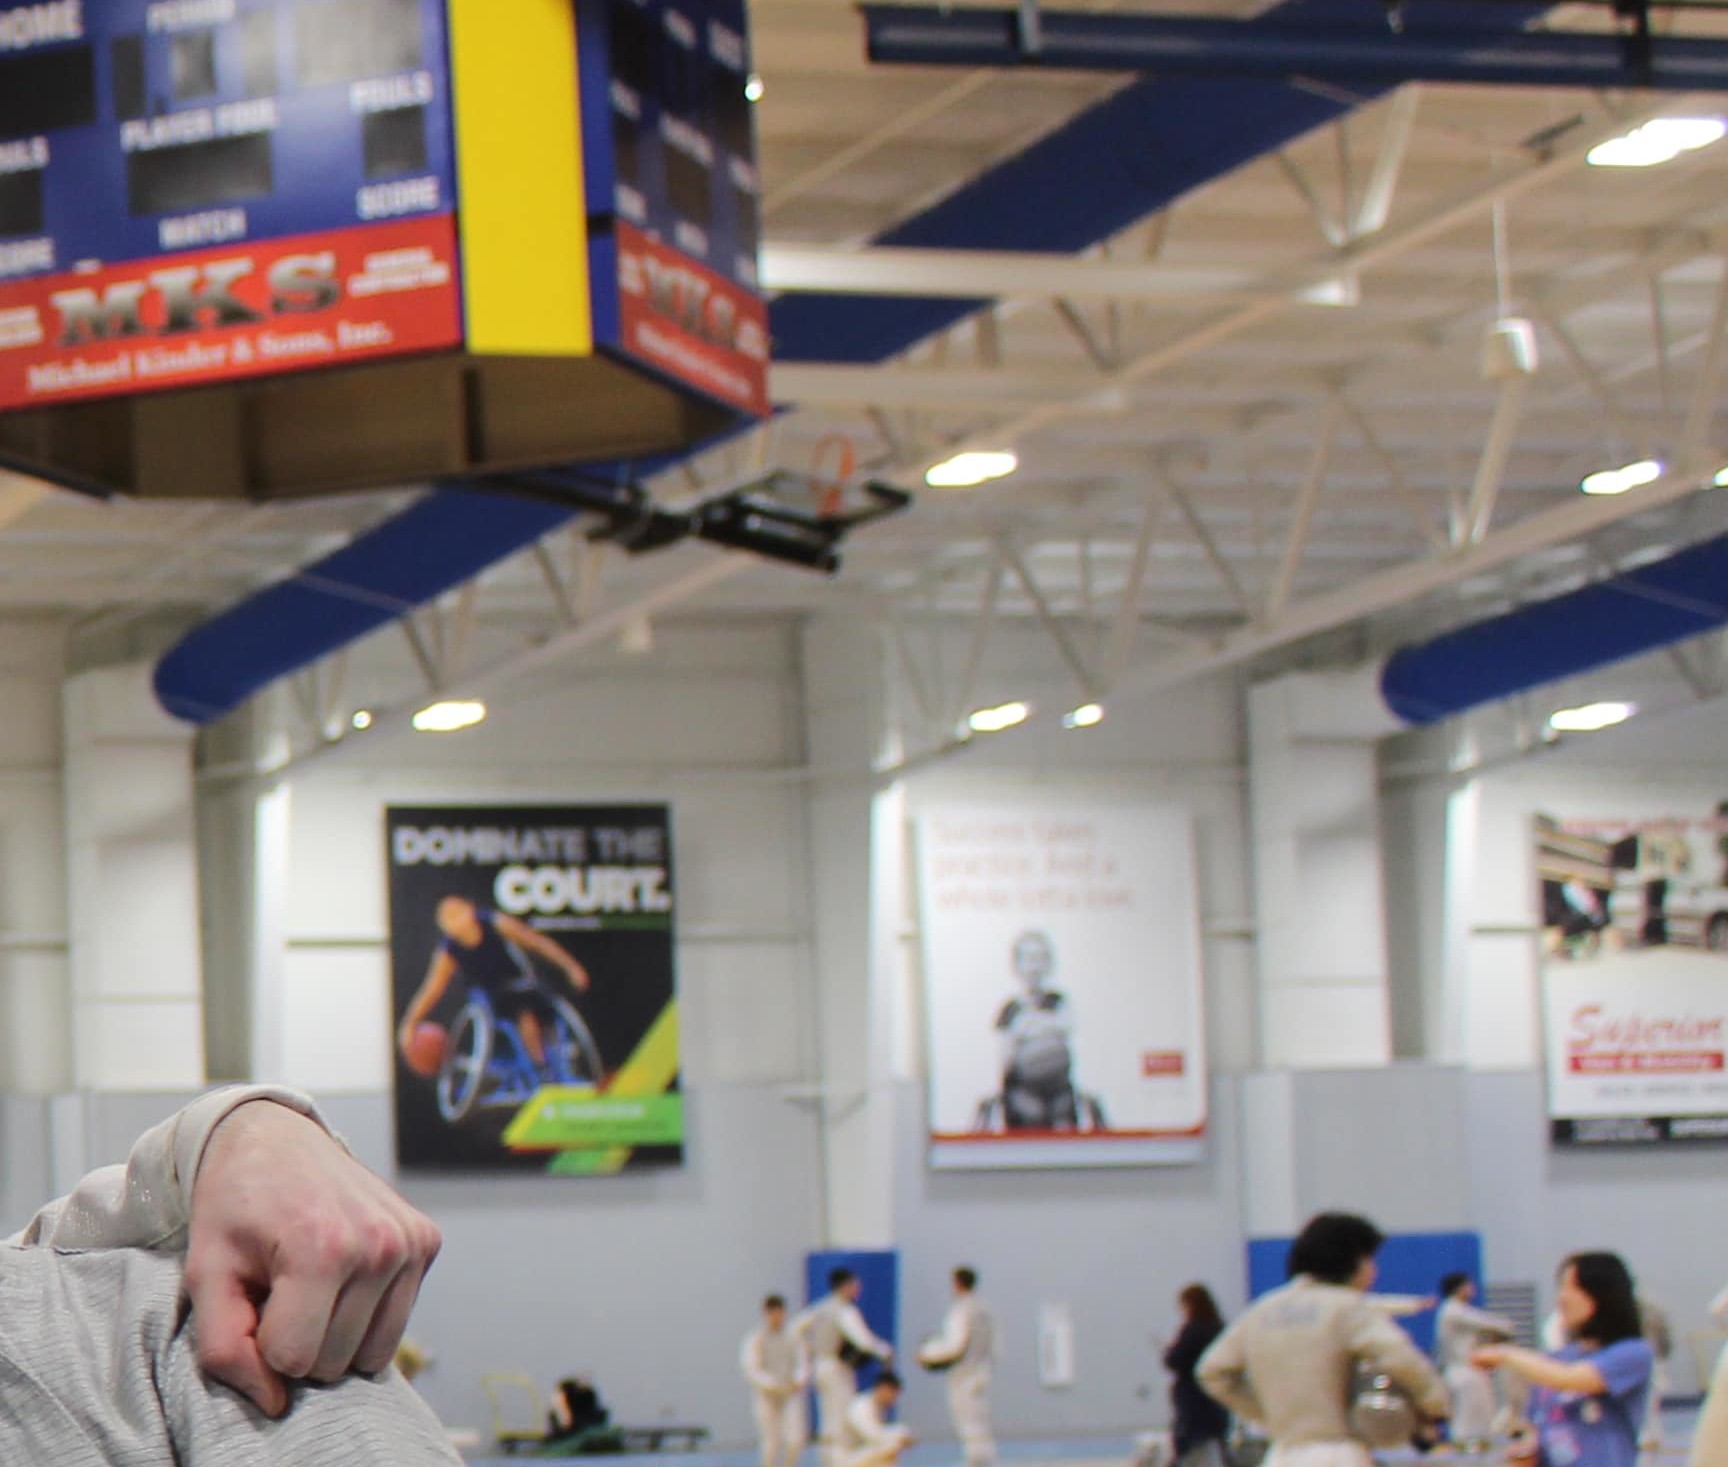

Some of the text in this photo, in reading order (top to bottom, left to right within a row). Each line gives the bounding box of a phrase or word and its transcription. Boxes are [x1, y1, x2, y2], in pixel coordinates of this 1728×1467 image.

[348, 70, 434, 115] FOULS
[120, 108, 214, 153] PLAYER
[356, 175, 440, 220] SCORE
[159, 207, 246, 249] MATCH
[48, 250, 341, 348] MKS
[26, 352, 132, 394] Michael
[134, 339, 228, 379] Kinder
[230, 337, 254, 364] &
[336, 320, 394, 350] Inc.
[394, 825, 664, 866] DOMINATE THE
[494, 864, 672, 914] COURT.
